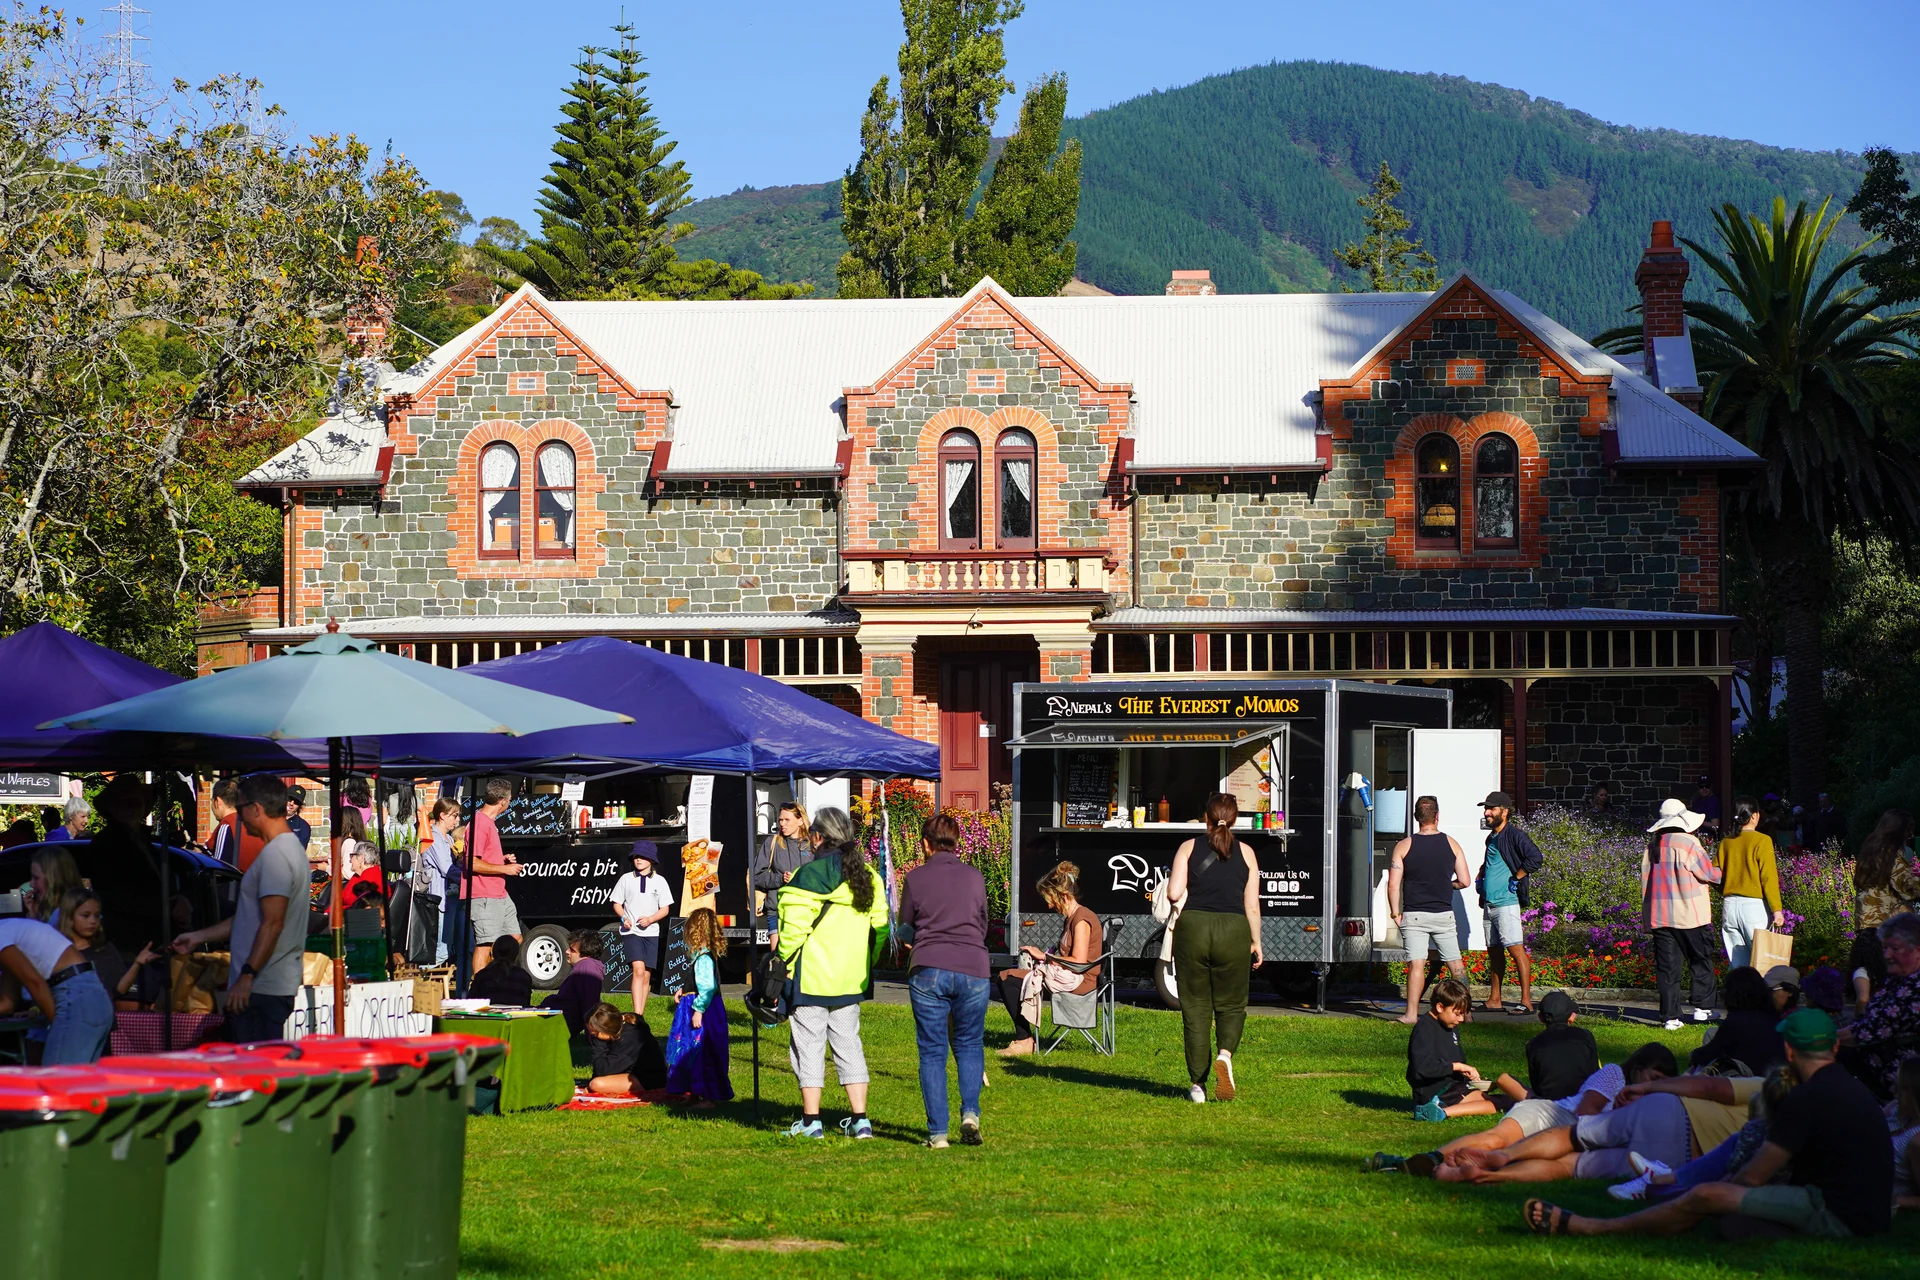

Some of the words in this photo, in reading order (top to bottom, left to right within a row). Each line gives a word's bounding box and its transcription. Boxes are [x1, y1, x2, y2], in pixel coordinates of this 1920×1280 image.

[1119, 696, 1153, 714] THE
[1159, 697, 1231, 714] EVEREST
[1235, 696, 1299, 717] MOMOS
[8, 773, 50, 787] WAFFLES
[520, 860, 577, 877] sounds
[580, 862, 590, 877] a
[594, 858, 618, 877] bit
[1288, 871, 1297, 879] US
[1299, 871, 1310, 879] ON
[612, 965, 629, 982] optio
